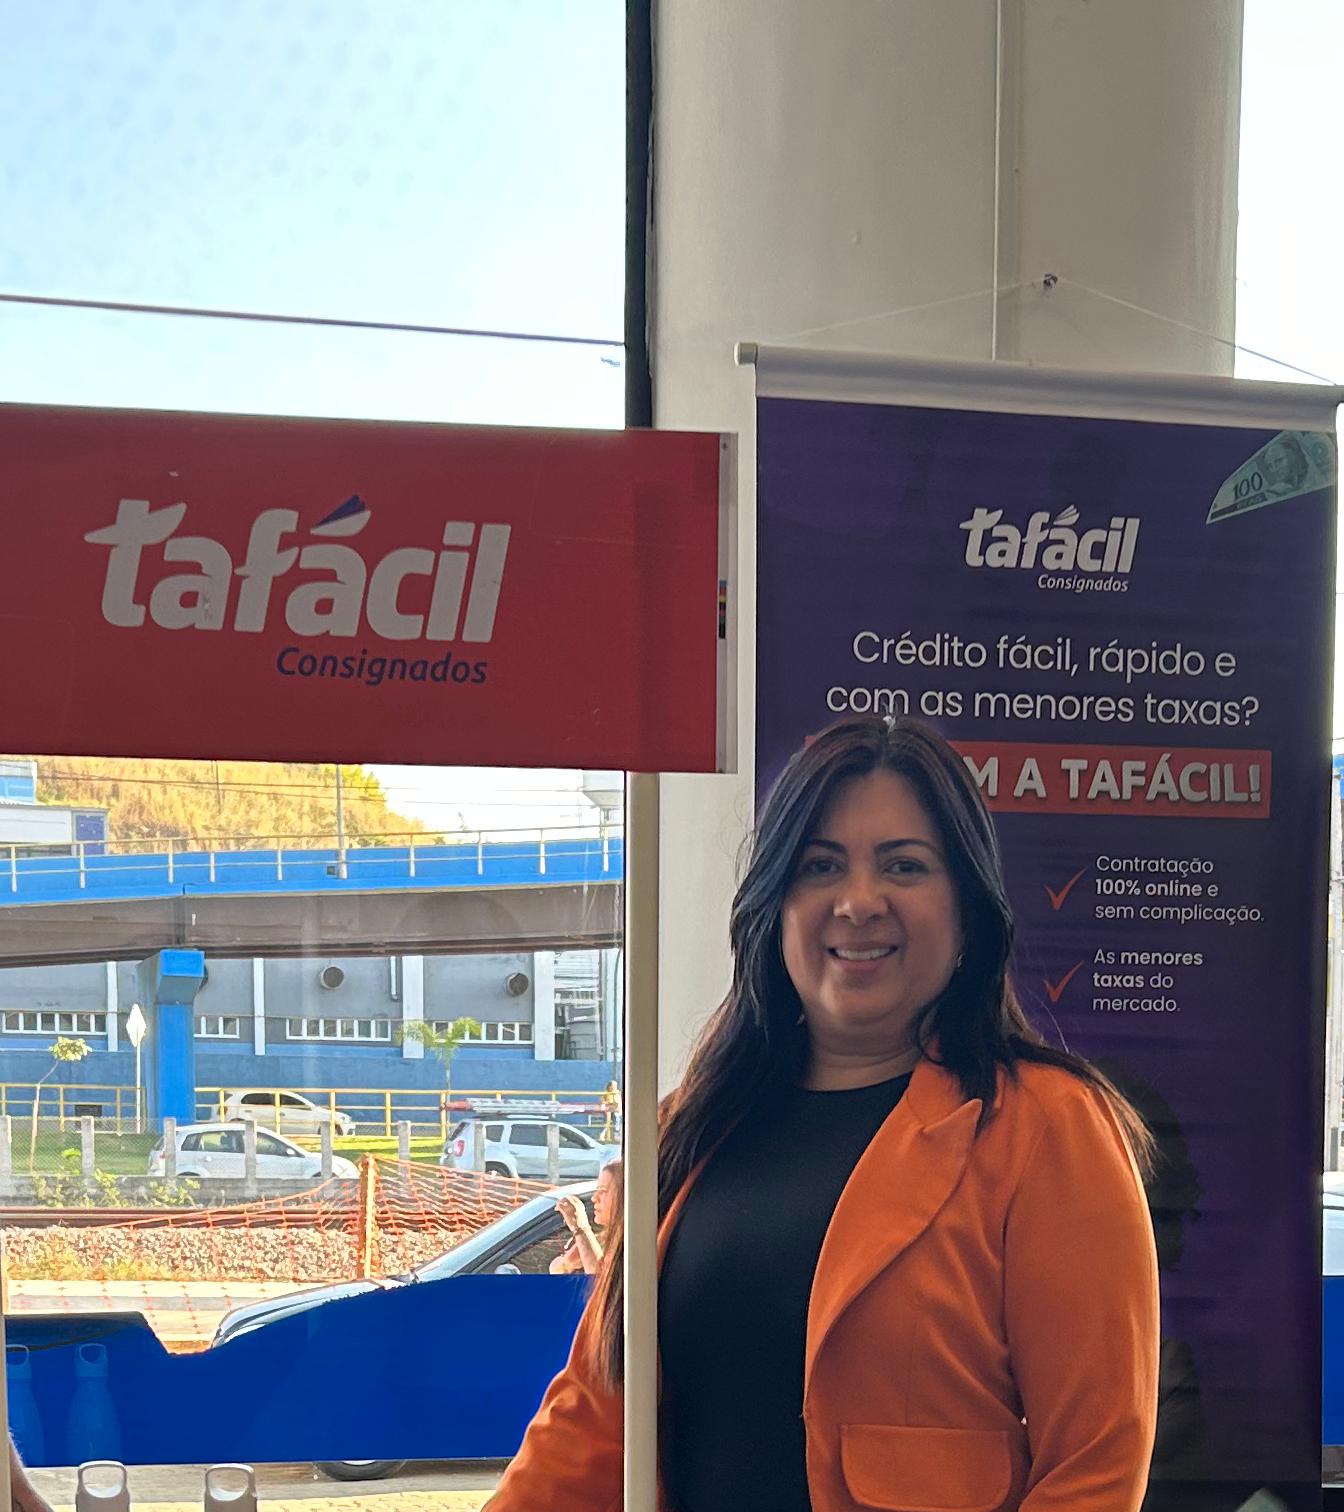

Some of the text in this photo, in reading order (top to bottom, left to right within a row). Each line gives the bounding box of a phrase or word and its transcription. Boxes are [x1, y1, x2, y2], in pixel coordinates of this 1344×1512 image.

[1233, 472, 1263, 500] 100
[959, 504, 1140, 574] tafácil
[84, 495, 511, 644] tafácil
[1038, 573, 1129, 594] Consignados
[276, 646, 488, 686] Consignados
[852, 631, 1236, 684] Crédito fácil, rápido e
[826, 686, 1260, 727] com as menores taxas?
[1013, 759, 1047, 798] A
[1061, 753, 1262, 803] TAFÁCIL!
[1096, 855, 1214, 878] Contratação
[1095, 878, 1219, 897] 100% online e
[1095, 901, 1264, 925] sem complicação.
[1093, 949, 1203, 967] As menores
[1093, 971, 1174, 989] taxas do
[1092, 994, 1181, 1013] mercado.
